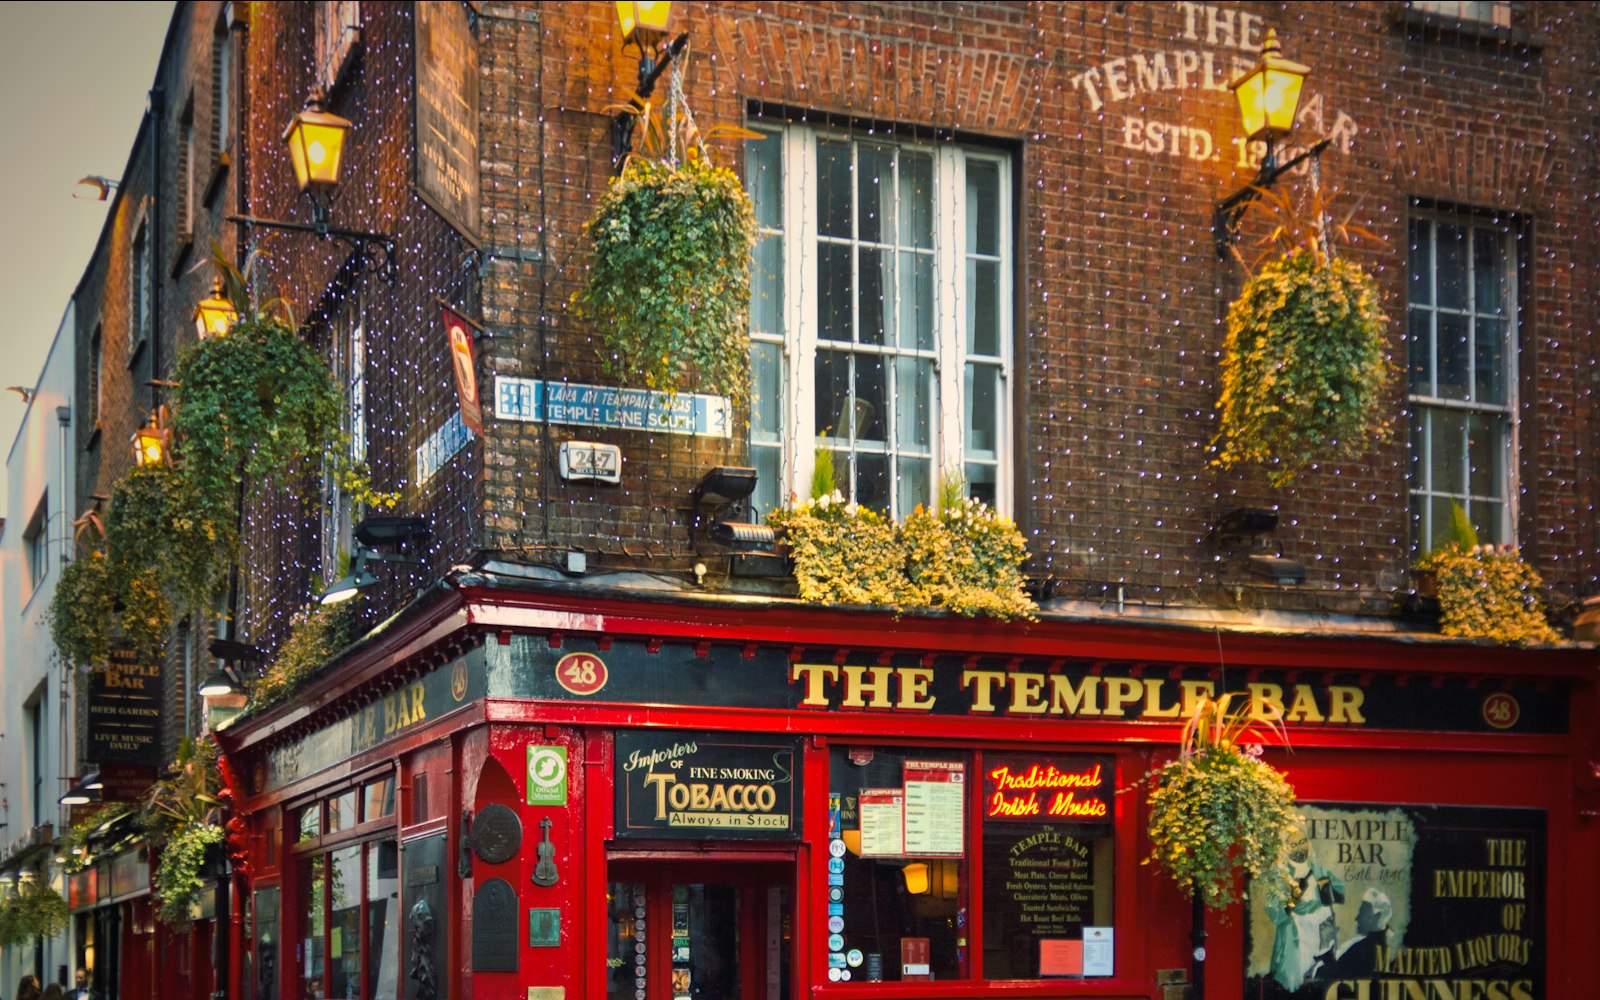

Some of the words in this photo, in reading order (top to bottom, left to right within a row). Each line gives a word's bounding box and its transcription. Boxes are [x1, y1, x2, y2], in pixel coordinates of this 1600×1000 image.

[1178, 2, 1264, 51] THE
[1123, 116, 1220, 161] ESTD.
[547, 404, 600, 421] TEMPLE
[605, 409, 641, 425] LANE
[648, 413, 695, 430] SOUTH
[94, 662, 160, 676] MPLE
[105, 671, 144, 689] BAR
[563, 657, 598, 685] 48
[792, 664, 937, 711] THE
[962, 670, 1216, 718] TEMPLE
[1247, 682, 1366, 724] BAR
[90, 706, 117, 714] BEER
[118, 707, 159, 716] GARDEN
[384, 681, 426, 734] BAR
[1488, 699, 1511, 721] 48
[109, 742, 139, 750] DAILY
[121, 735, 153, 743] MUSIC
[623, 741, 698, 773] Importers
[670, 760, 684, 769] OF
[905, 761, 919, 769] THE
[920, 761, 948, 769] TEMPLE
[949, 762, 963, 770] BAR
[690, 767, 718, 779] FINE
[719, 767, 775, 781] SMOKING
[991, 764, 1102, 790] Traditional
[989, 791, 1040, 817] Irish
[1048, 791, 1107, 817] Music
[671, 812, 721, 826] Always
[729, 815, 741, 826] in
[747, 813, 787, 827] Stock
[1306, 818, 1410, 841] TEMPLE
[1010, 832, 1061, 856] TEMPLE
[1065, 836, 1088, 858] BAR
[1337, 842, 1387, 867] BAR
[1487, 839, 1526, 866] THE
[1009, 858, 1050, 866] Traditional
[1053, 858, 1070, 866] Food
[1006, 881, 1022, 890] Fresh
[1014, 871, 1029, 879] Meat
[1434, 870, 1526, 899] EMPEROR
[1503, 903, 1526, 931] OF
[1374, 944, 1452, 976] MALTED
[1455, 933, 1533, 971] LIQUORS
